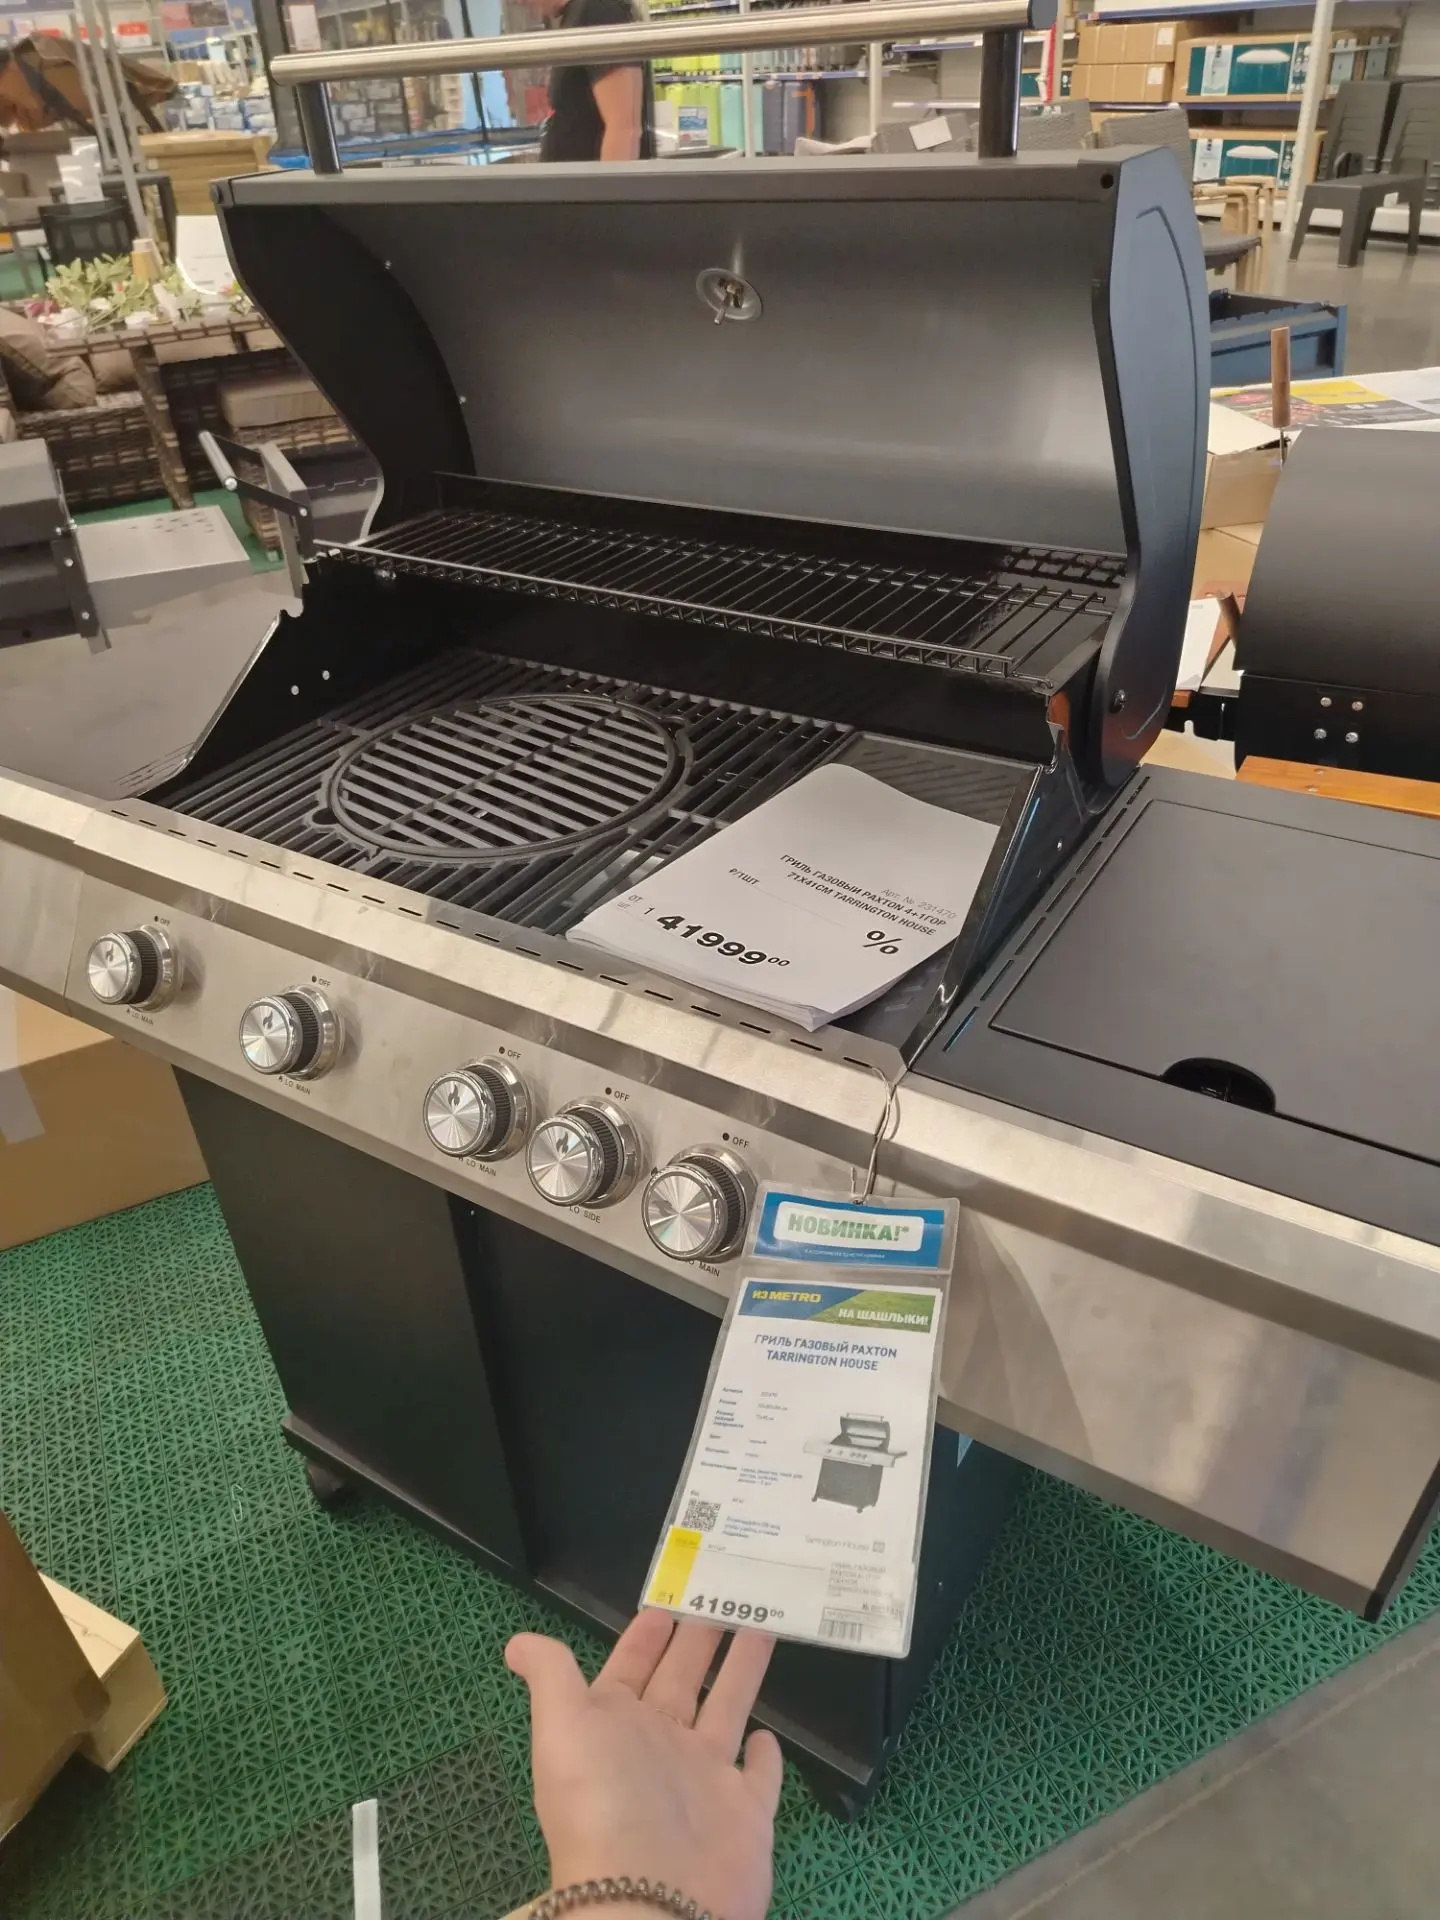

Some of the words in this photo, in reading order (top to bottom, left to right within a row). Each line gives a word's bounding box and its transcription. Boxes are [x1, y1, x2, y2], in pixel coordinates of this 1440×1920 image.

[780, 854, 812, 874] ГРИЛЬ
[812, 870, 862, 895] ГАЗОВЫЙ
[861, 891, 903, 912] PAXTON
[904, 907, 947, 927] 4+1ГОР
[787, 872, 834, 895] 71Х41СМ
[834, 891, 900, 922] TARRINGTON
[898, 916, 937, 936] HOUSE
[917, 901, 957, 920] 231470
[644, 907, 655, 915] 1
[657, 915, 767, 964] 41999
[862, 930, 903, 955] %
[318, 979, 331, 987] OFF
[507, 1050, 522, 1060] OFF
[284, 1080, 294, 1088] LO
[296, 1083, 311, 1095] MAIN
[614, 1091, 631, 1102] OFF
[732, 1137, 750, 1149] OFF
[466, 1158, 476, 1167] LO
[479, 1162, 497, 1176] MAIN
[569, 1205, 580, 1214] LO
[583, 1209, 601, 1223] SIDE
[698, 1262, 720, 1277] MAIN
[752, 1290, 770, 1300] ИЗ
[771, 1291, 822, 1303] METRO
[838, 1307, 855, 1319] НА
[856, 1310, 929, 1326] ШАШЛЫКИ!
[754, 1334, 792, 1347] ГРИЛЬ
[793, 1337, 848, 1354] ГАЗОВЫЙ
[850, 1344, 898, 1358] PAXTON
[766, 1350, 837, 1367] TARRINGTON
[839, 1358, 879, 1371] HOUSE
[668, 1593, 674, 1605] 1
[689, 1595, 768, 1623] 41999
